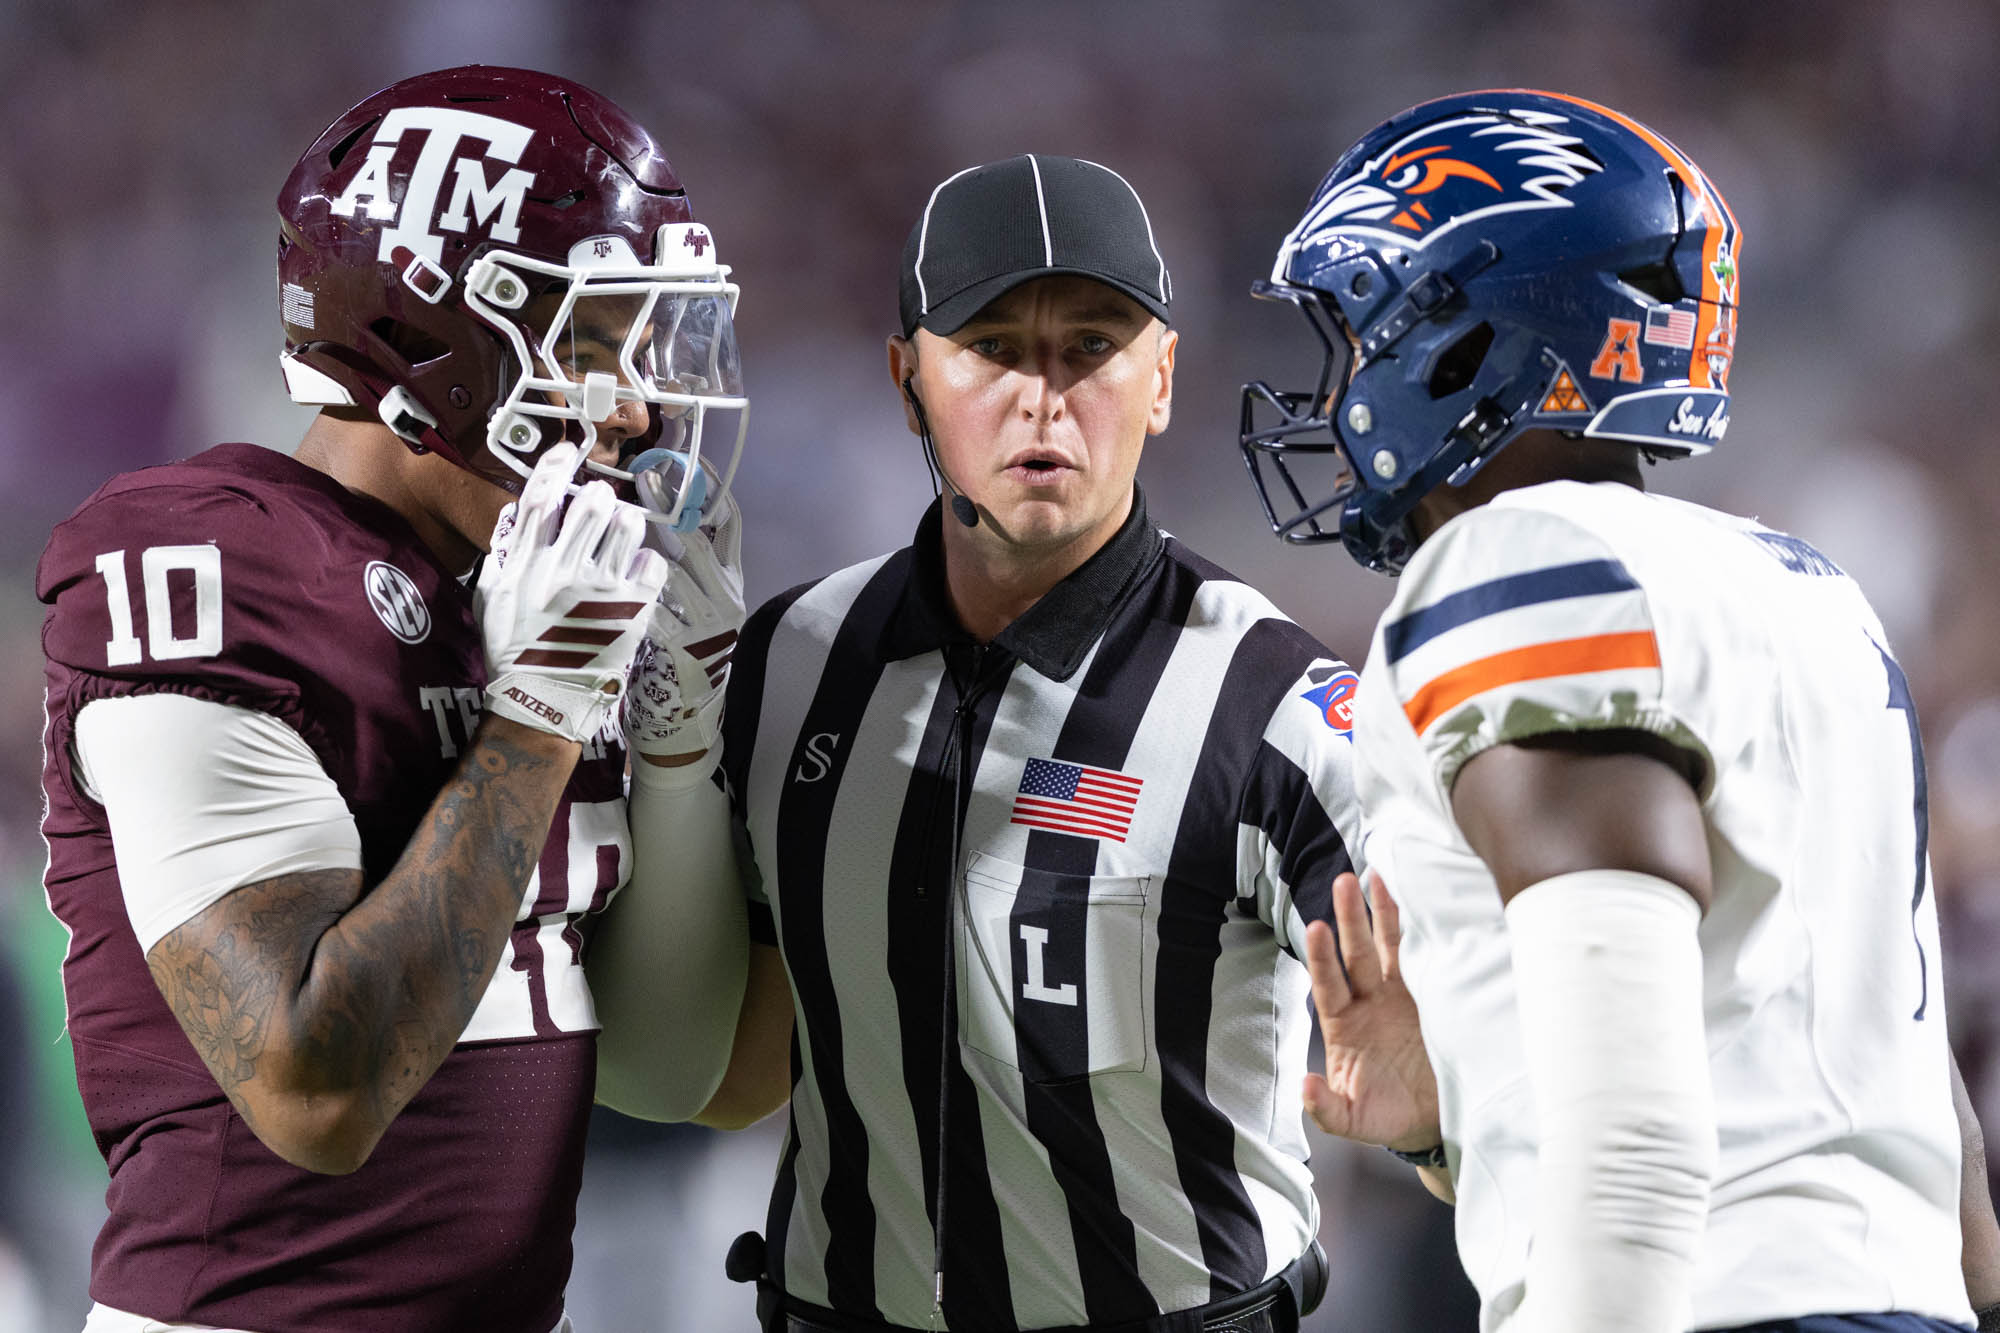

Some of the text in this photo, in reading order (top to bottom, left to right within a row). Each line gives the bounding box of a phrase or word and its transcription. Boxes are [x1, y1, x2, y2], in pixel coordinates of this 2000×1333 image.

[1589, 317, 1644, 384] A
[95, 544, 223, 667] 10
[369, 566, 426, 636] SEC
[502, 686, 564, 726] ADIZERO
[795, 733, 841, 783] S
[1020, 924, 1078, 1006] L
